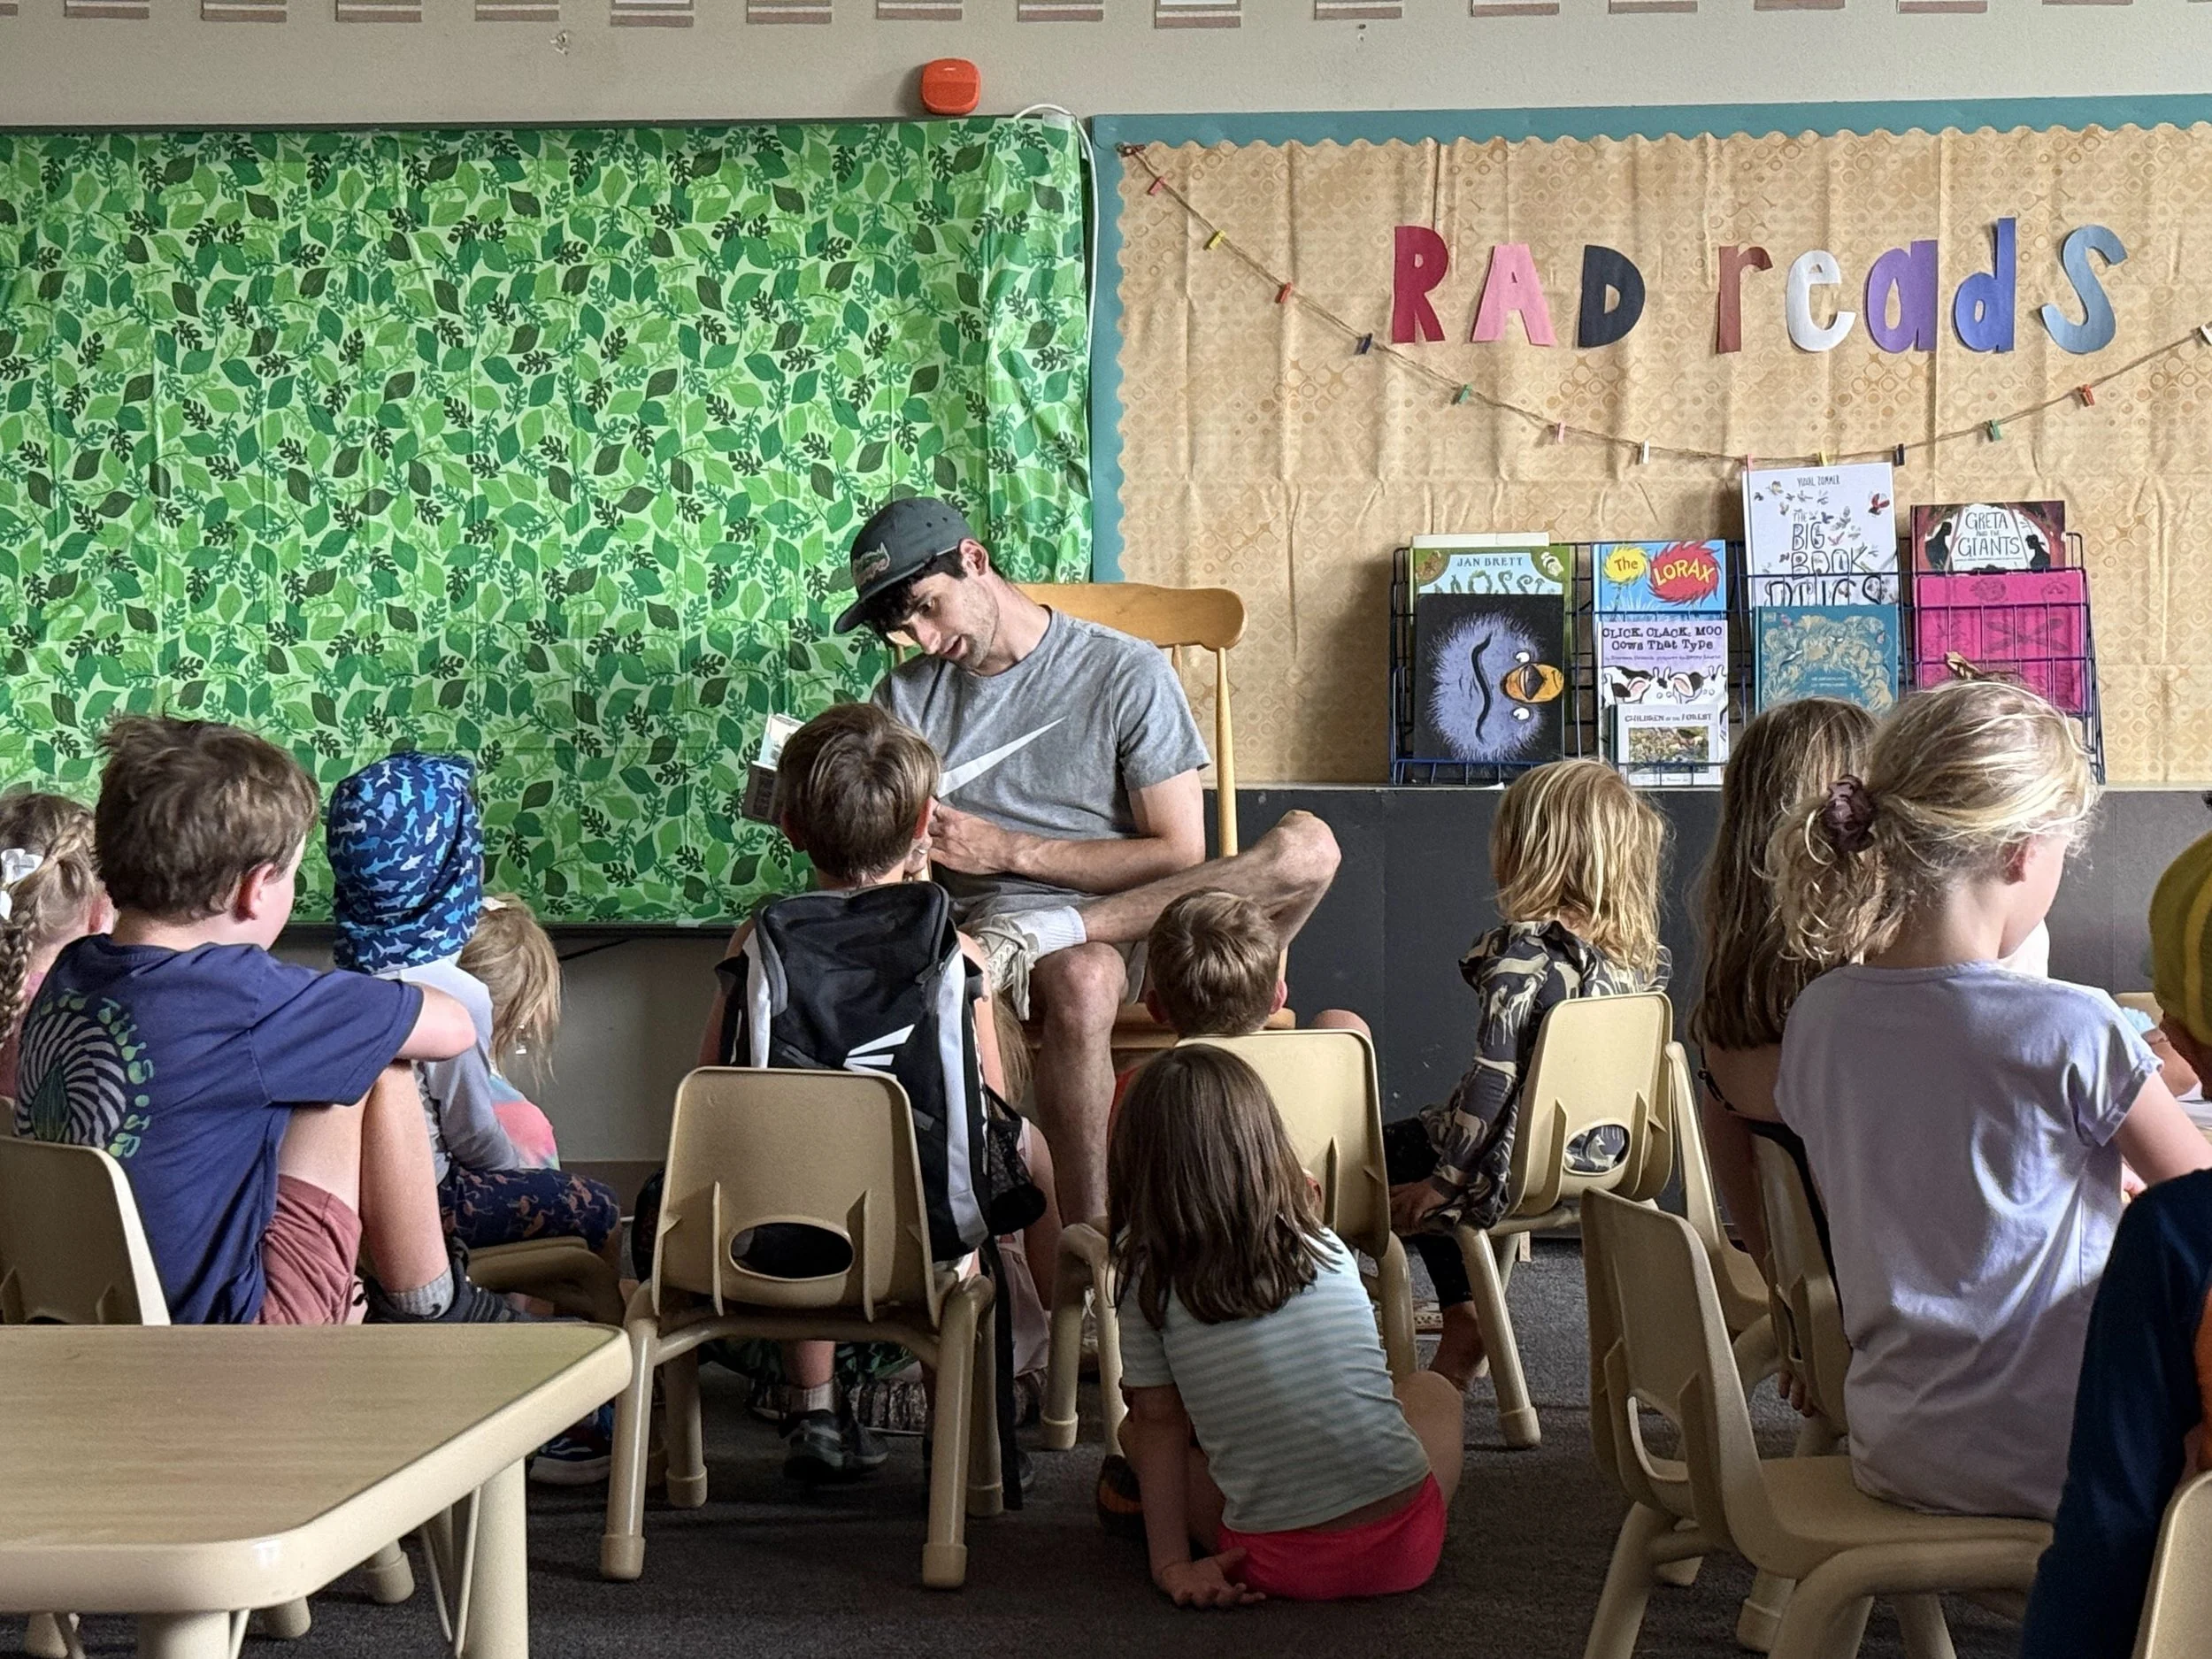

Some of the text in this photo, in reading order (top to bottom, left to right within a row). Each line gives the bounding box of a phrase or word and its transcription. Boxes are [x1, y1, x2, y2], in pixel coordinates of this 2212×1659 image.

[1392, 226, 1646, 348] RAD
[1965, 511, 2008, 530] GRETA
[1792, 522, 1824, 550] BIG
[1958, 536, 2020, 557] GIANTS
[1457, 557, 1523, 567] JAN BRETT
[1614, 557, 1716, 586] The LORAX
[1791, 547, 1868, 580] BOOK
[1695, 626, 1722, 636] MOO
[1612, 639, 1713, 652] Cows That Type
